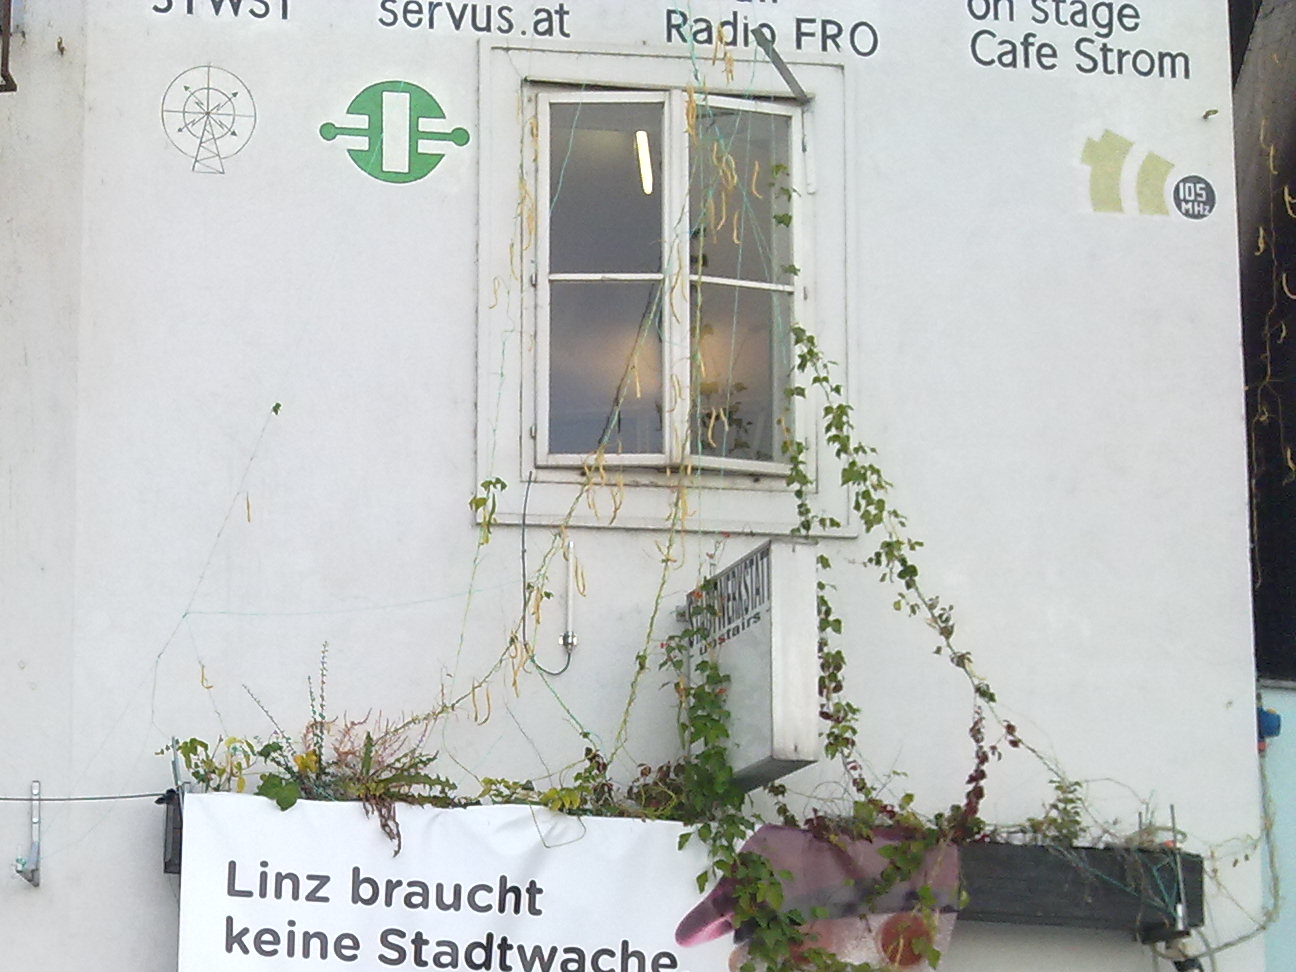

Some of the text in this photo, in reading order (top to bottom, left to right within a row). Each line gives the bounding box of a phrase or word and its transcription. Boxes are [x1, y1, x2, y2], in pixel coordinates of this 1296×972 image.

[378, 0, 571, 39] servus.at
[665, 9, 879, 57] Radio FRO
[1031, 0, 1141, 38] stage
[970, 29, 1190, 79] Cafe Strom
[1179, 182, 1206, 202] 105
[1180, 201, 1210, 216] MHz
[226, 860, 544, 917] Linz braucht
[224, 915, 361, 963] keine
